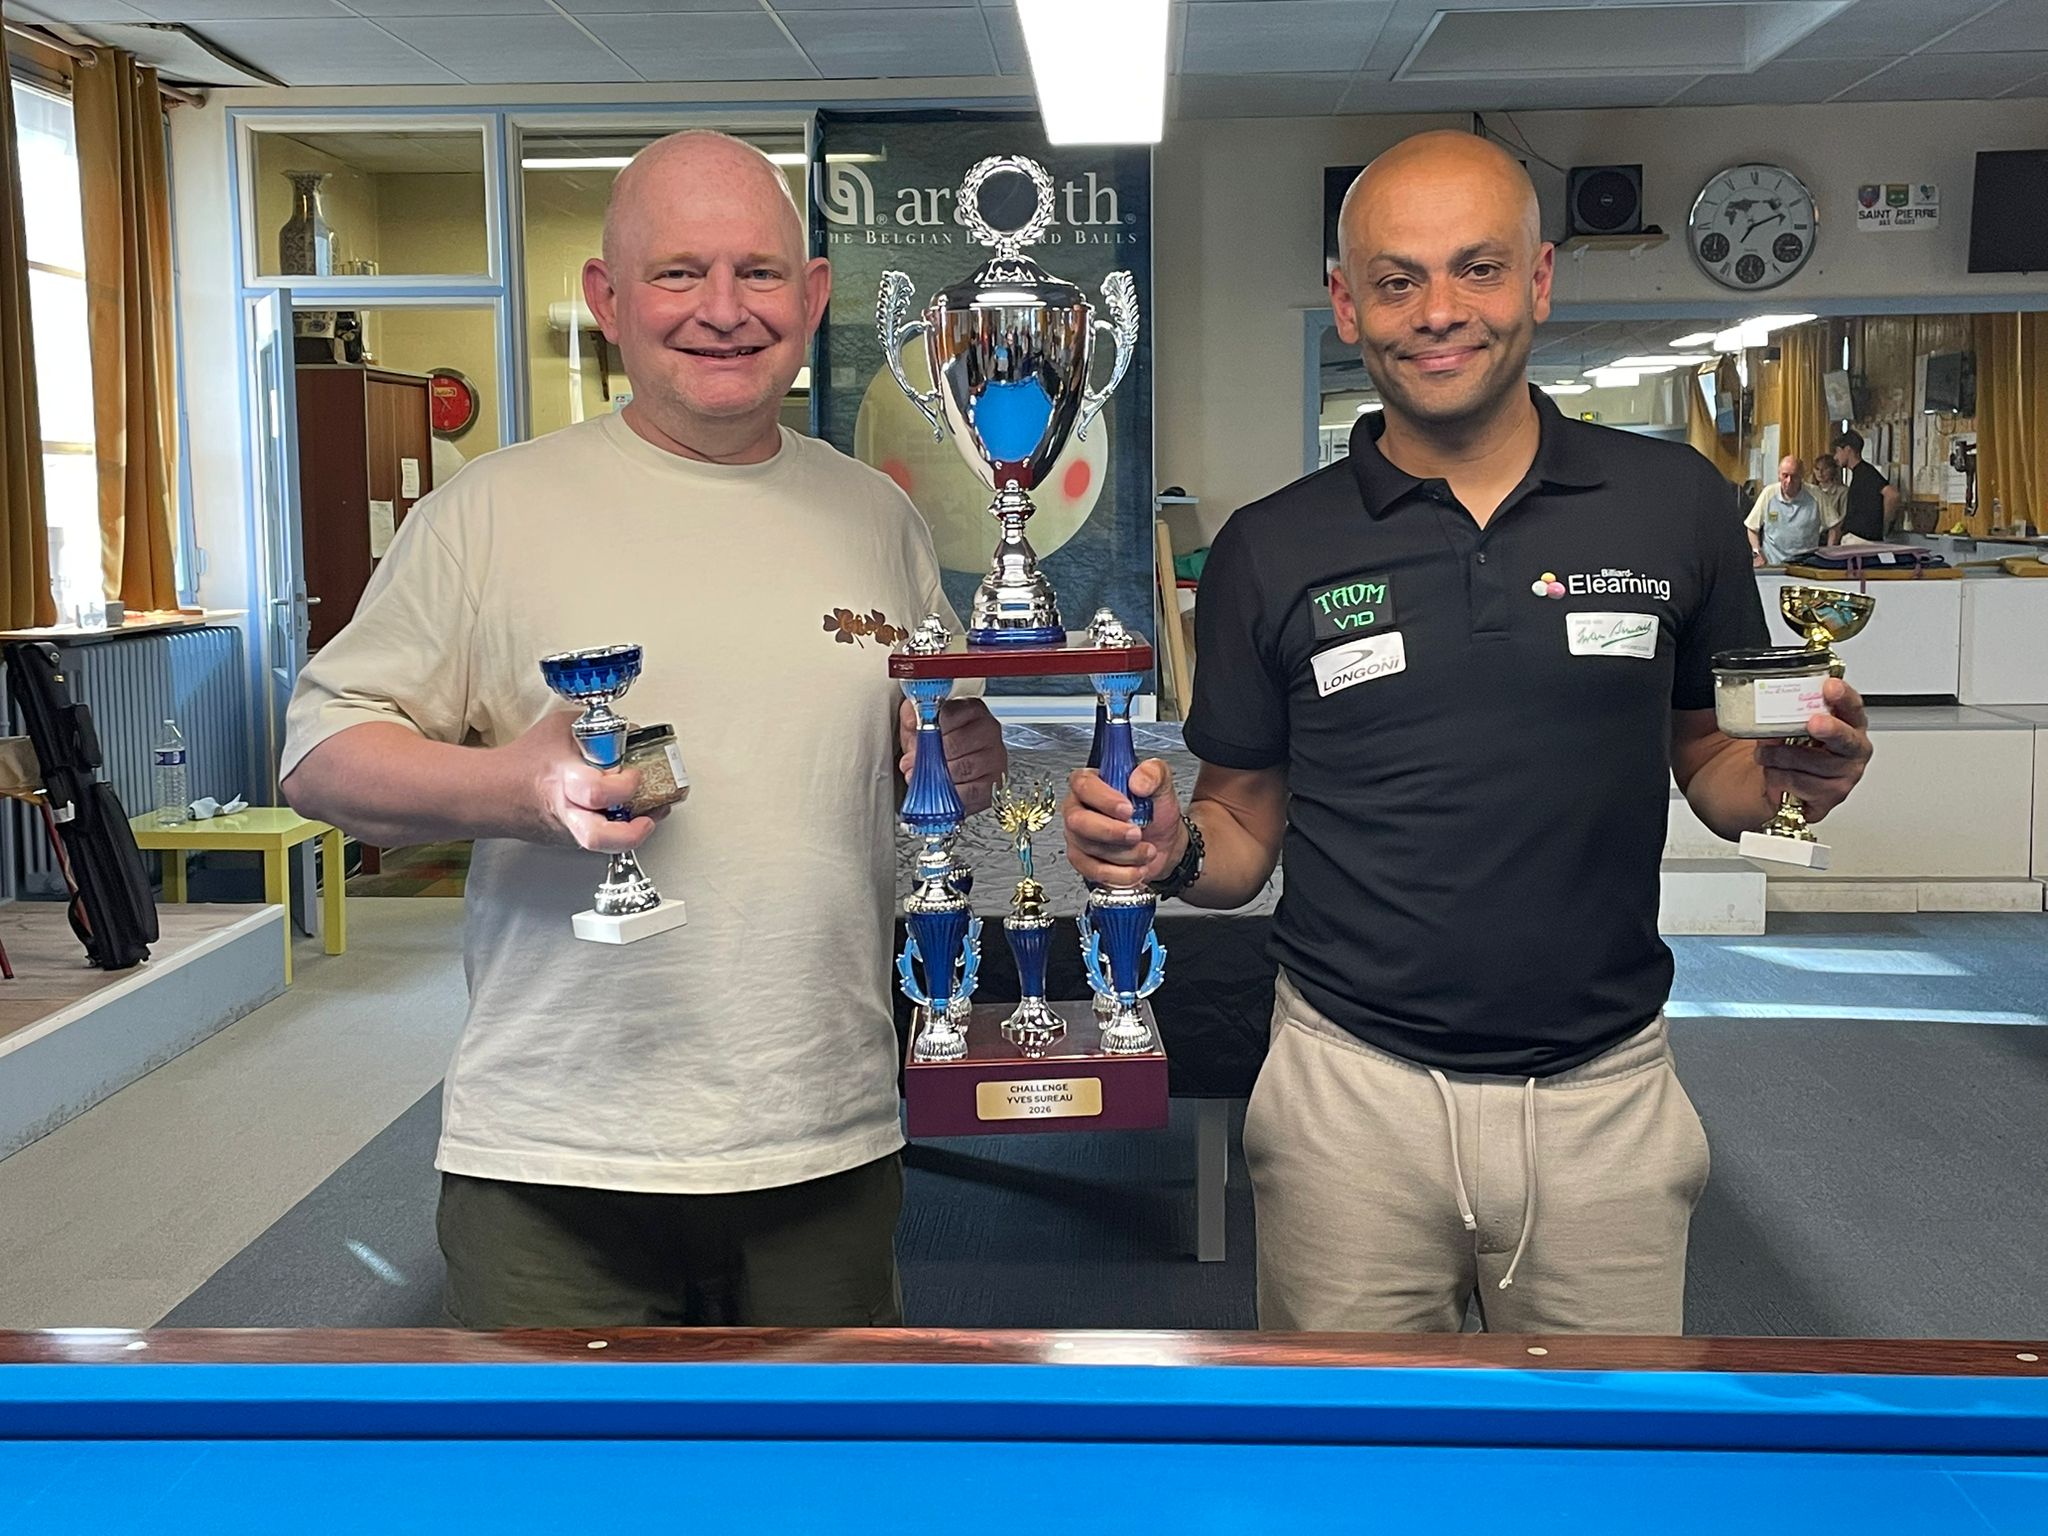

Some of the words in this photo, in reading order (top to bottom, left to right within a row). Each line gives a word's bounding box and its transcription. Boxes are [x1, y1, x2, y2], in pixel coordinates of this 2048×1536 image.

[895, 172, 1124, 226] arth
[1858, 209, 1892, 220] SAINT
[1896, 208, 1937, 219] PIERRE
[815, 230, 853, 244] THE
[866, 229, 953, 245] BELGIAN
[1075, 230, 1137, 244] BALLS
[1568, 574, 1671, 601] Elearning
[1333, 610, 1375, 630] V10
[1323, 659, 1400, 692] LONGONI
[1010, 1083, 1068, 1093] CHALLENGE
[1007, 1096, 1033, 1104] YVES
[1034, 1094, 1073, 1103] SUREAU
[1029, 1106, 1052, 1114] 2026
